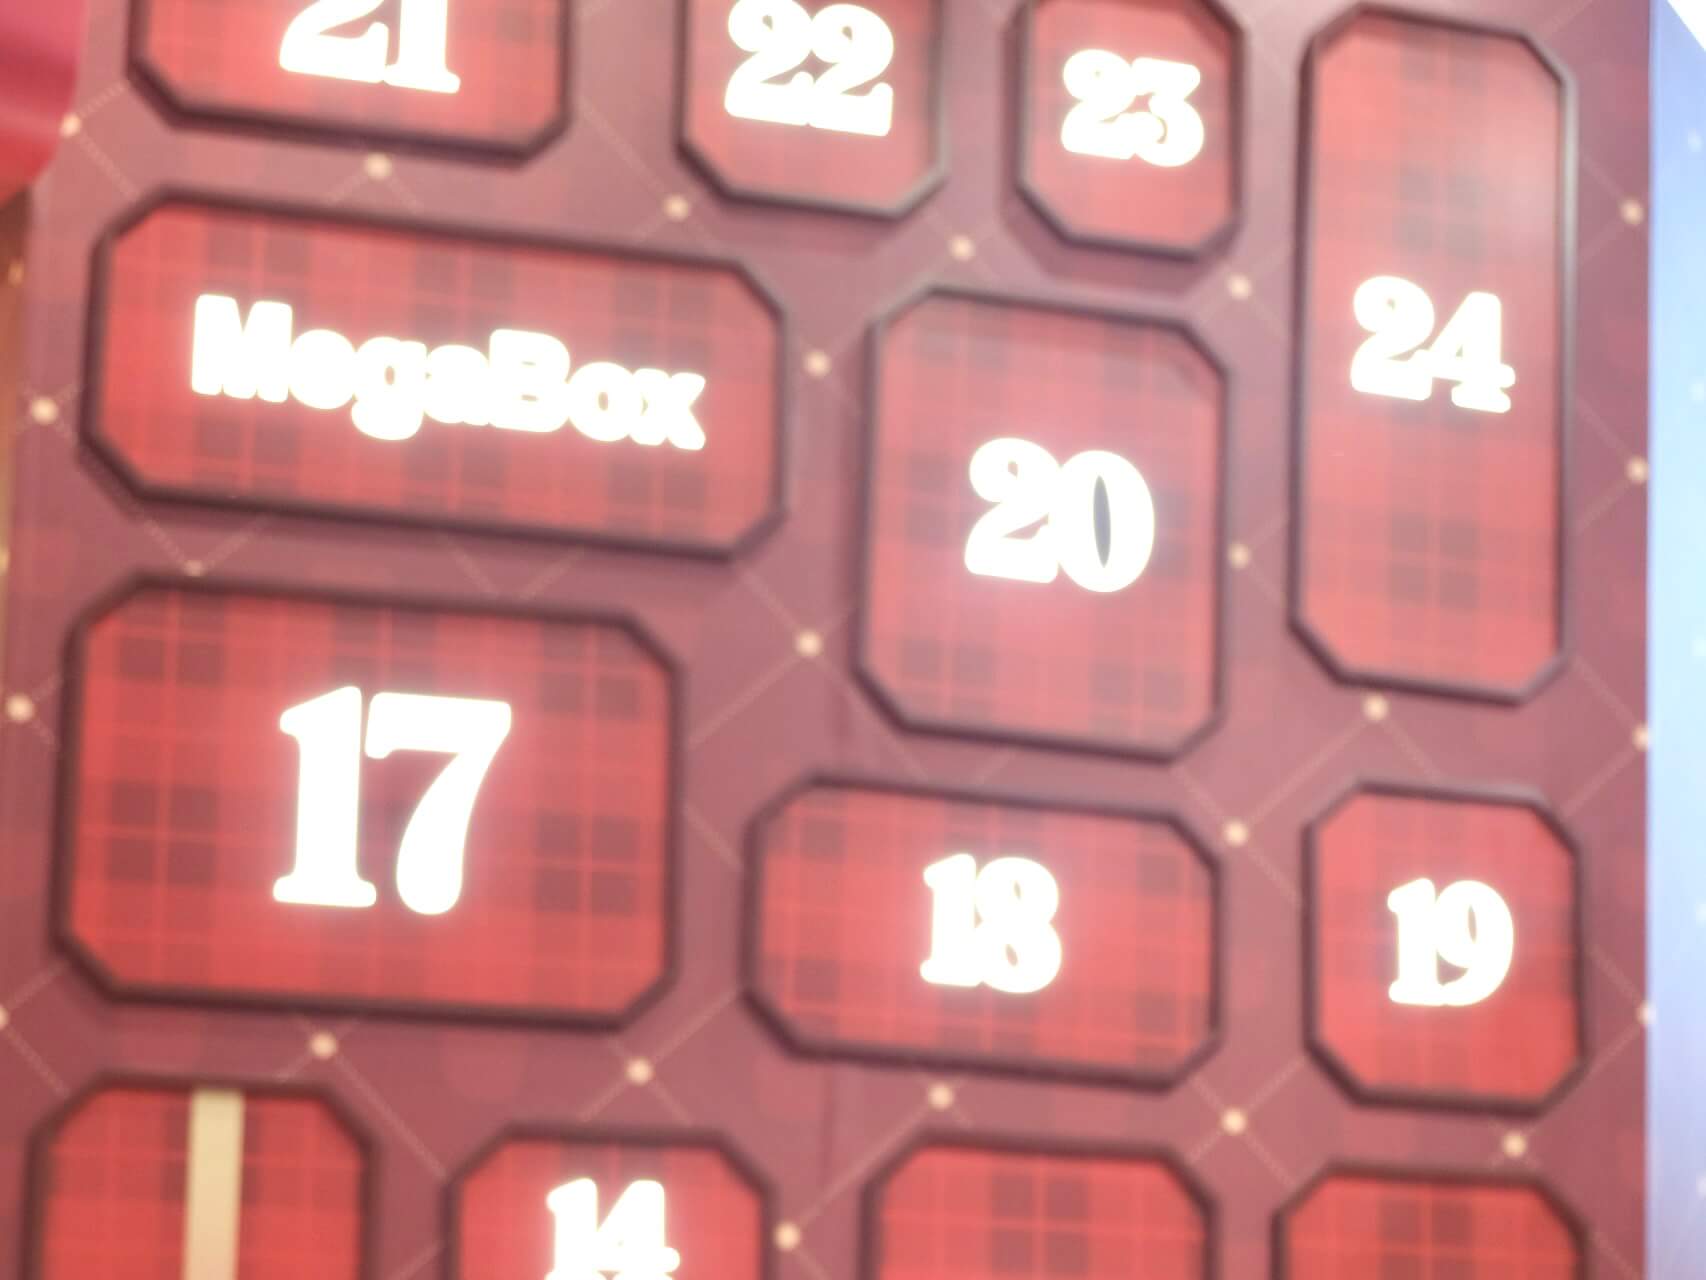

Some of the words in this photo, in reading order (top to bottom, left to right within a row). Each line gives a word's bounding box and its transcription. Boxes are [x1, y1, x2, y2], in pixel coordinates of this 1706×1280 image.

[724, 0, 894, 136] 22
[1061, 49, 1205, 167] 23
[190, 294, 706, 450] MegaBox
[1350, 275, 1517, 413] 24
[964, 437, 1155, 593] 20
[272, 685, 513, 915] 17
[919, 854, 1062, 994] 18
[1386, 878, 1515, 1007] 19
